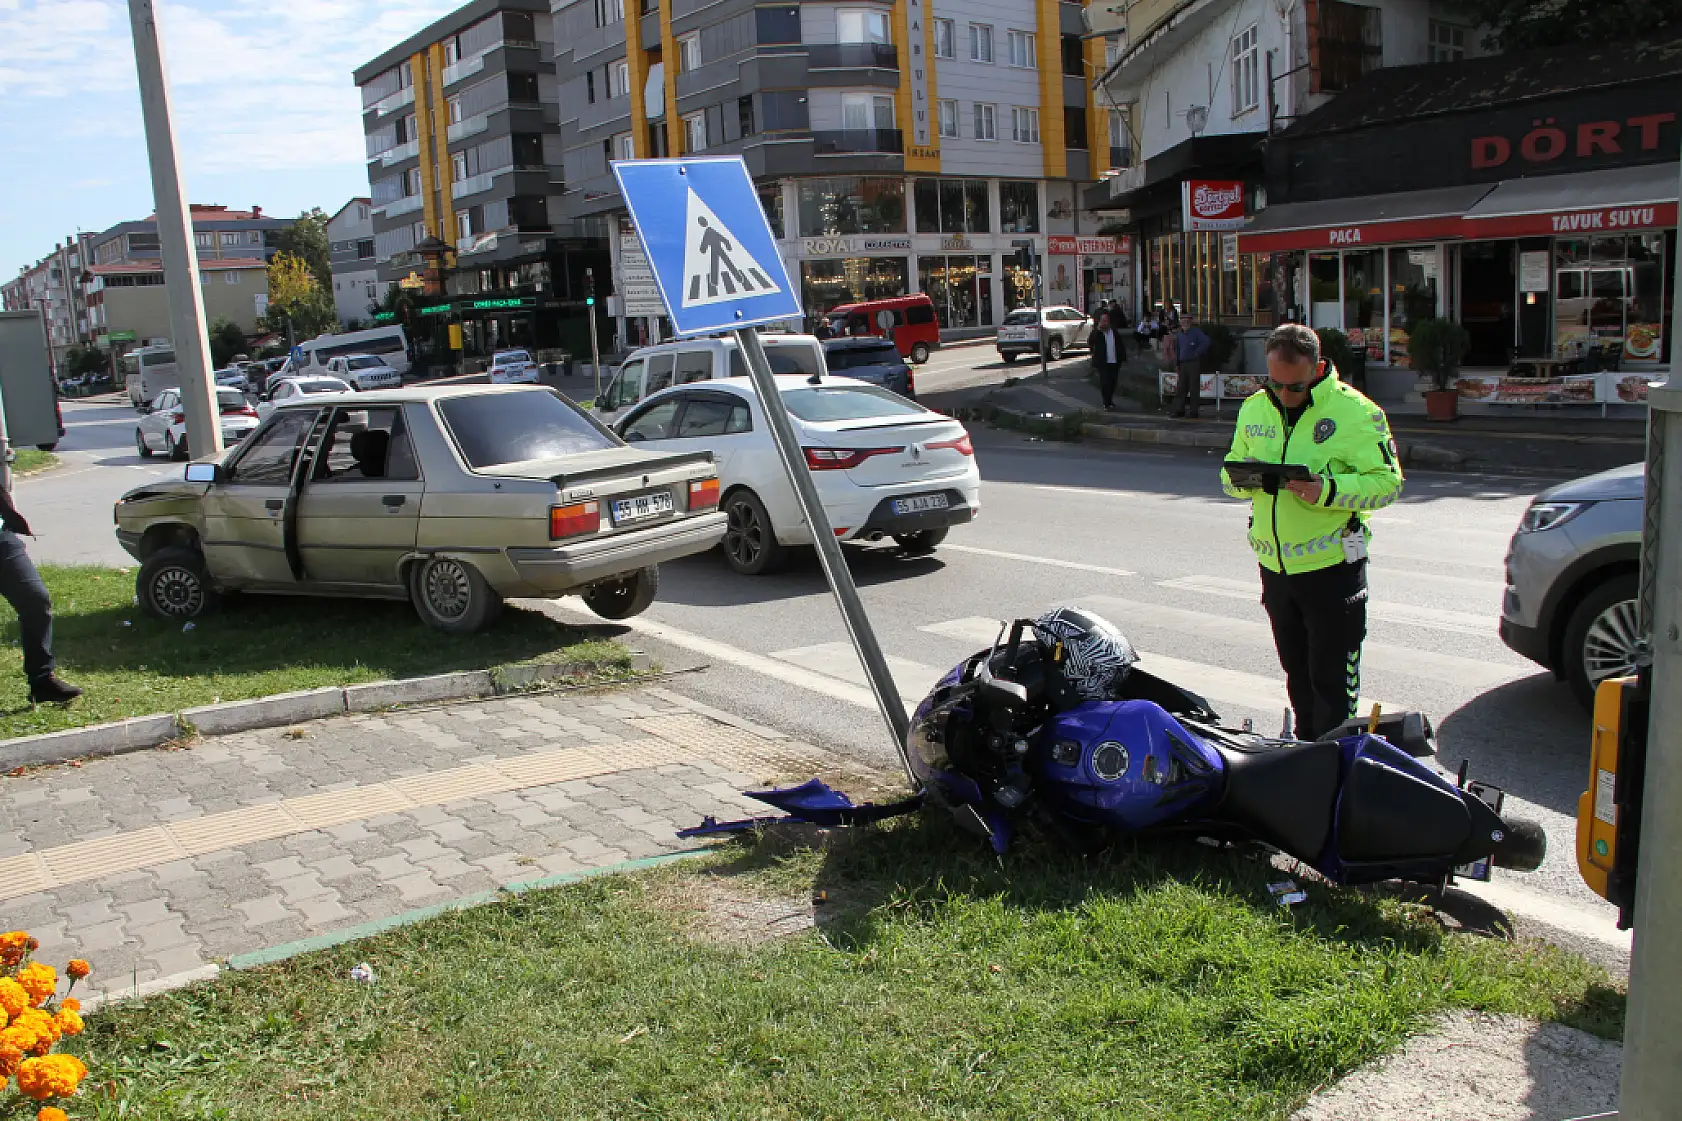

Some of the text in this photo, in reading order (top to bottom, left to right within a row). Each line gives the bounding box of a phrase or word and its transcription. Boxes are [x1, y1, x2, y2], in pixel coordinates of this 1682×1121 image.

[1470, 112, 1677, 170] DÖRT
[1552, 208, 1654, 231] TAVUK SUYU
[1329, 228, 1361, 245] PAÇA
[803, 237, 857, 254] ROYAL
[618, 501, 632, 517] 55
